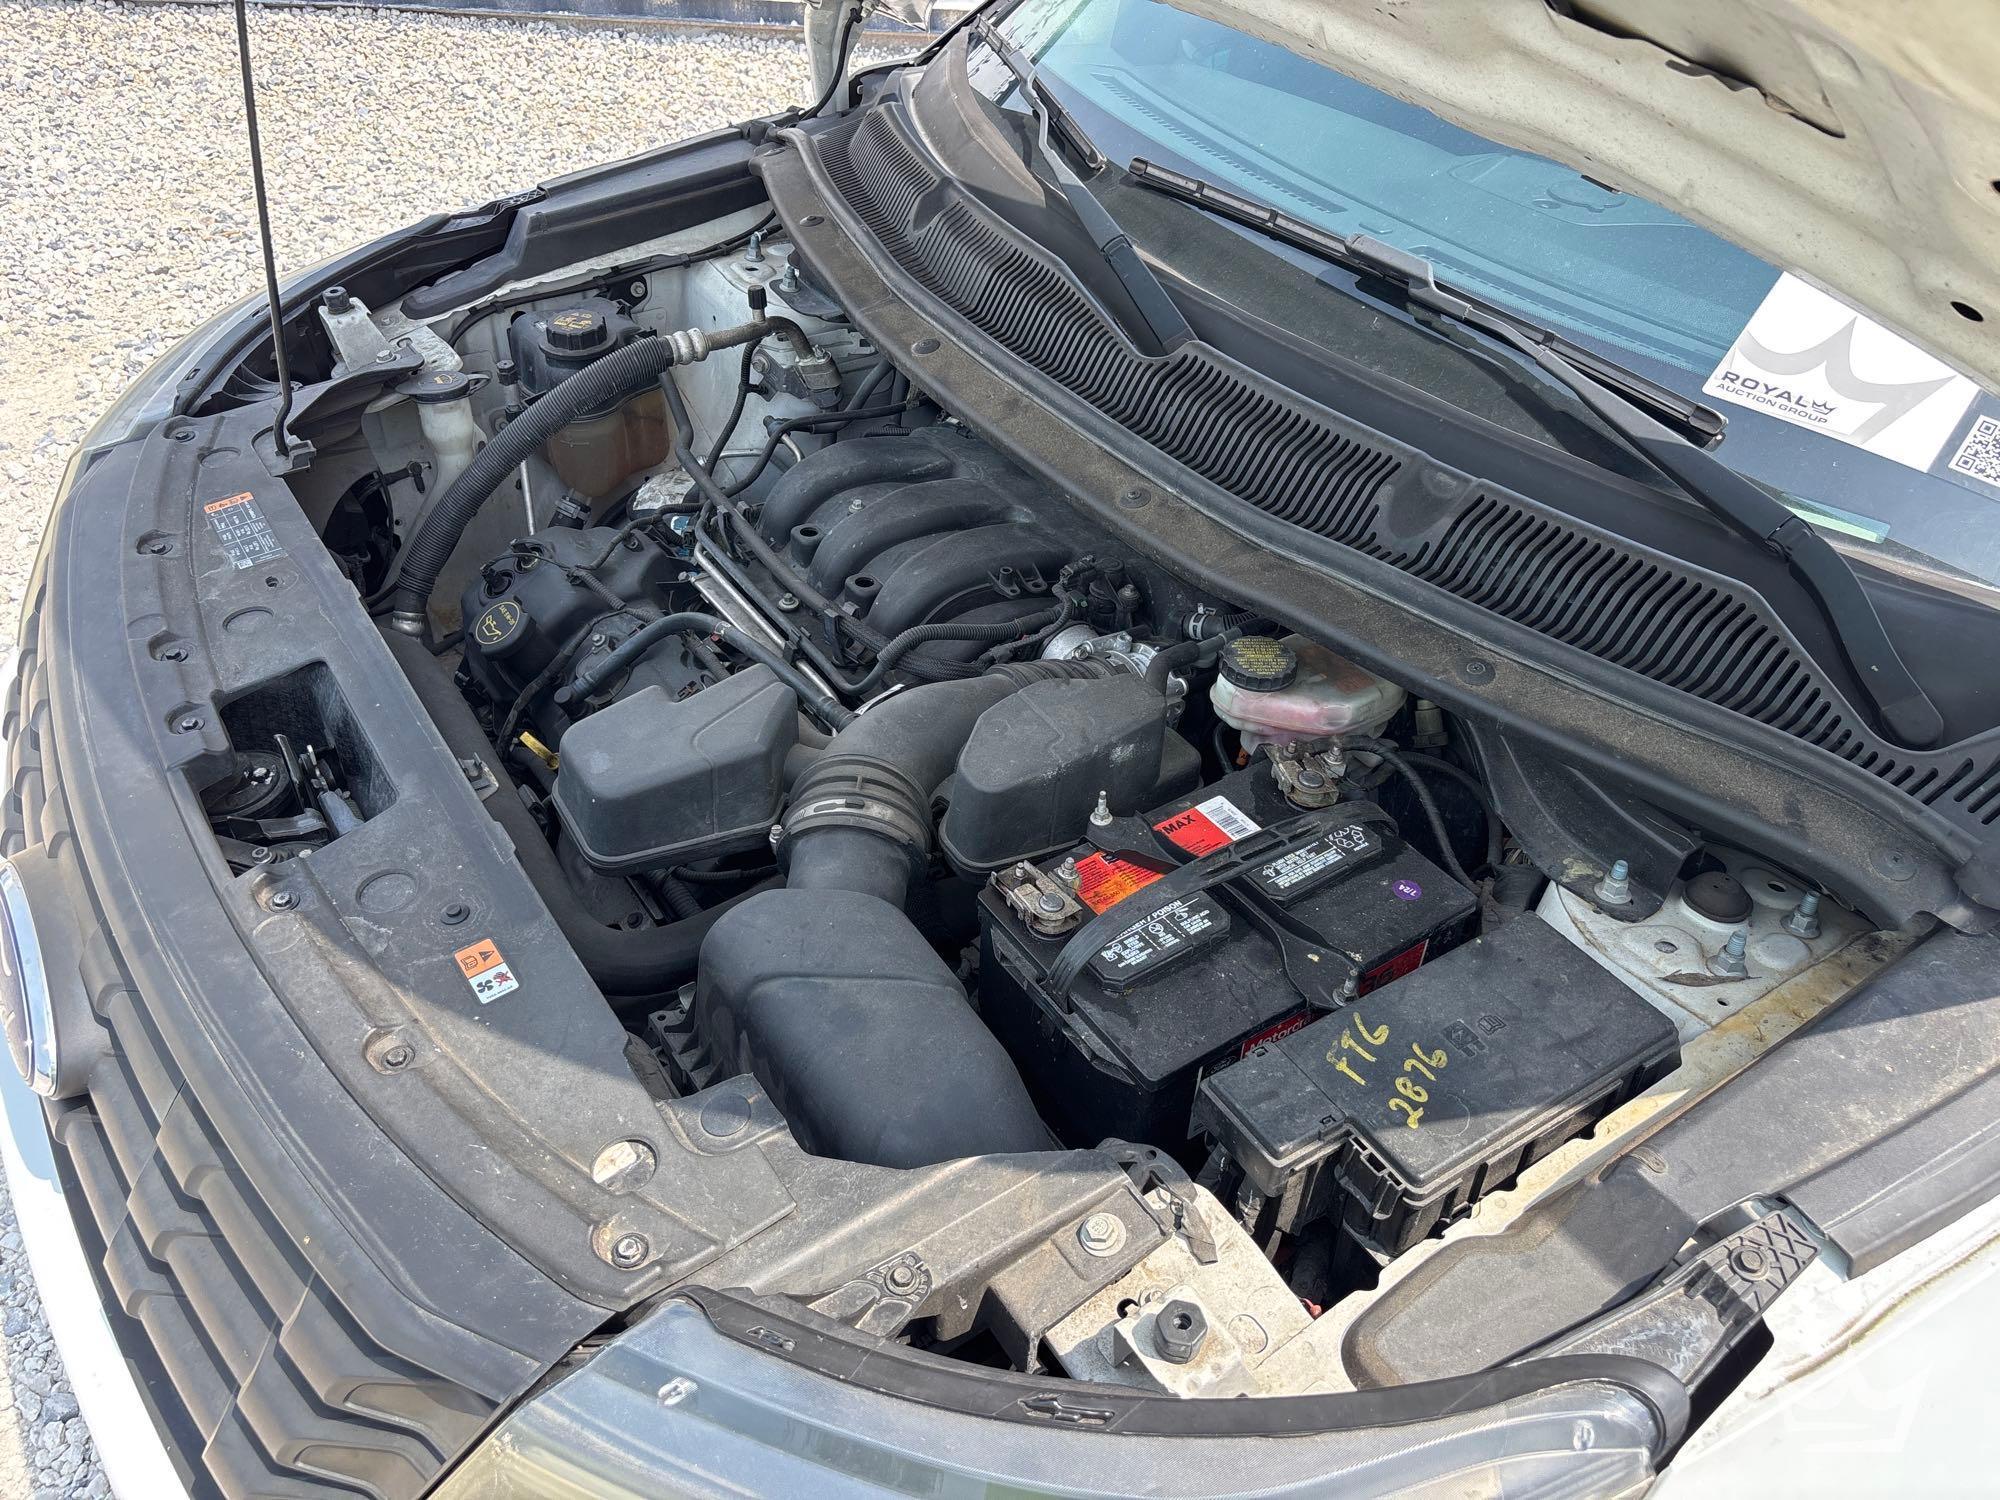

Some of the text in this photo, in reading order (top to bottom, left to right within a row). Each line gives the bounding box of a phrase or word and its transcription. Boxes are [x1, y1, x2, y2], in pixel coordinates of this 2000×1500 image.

[1716, 383, 1828, 424] AUCTION GROUP
[1721, 371, 1807, 408] ROYAL
[1162, 814, 1196, 835] MAX
[1151, 899, 1183, 919] POISON
[1388, 1042, 1448, 1129] 2876
